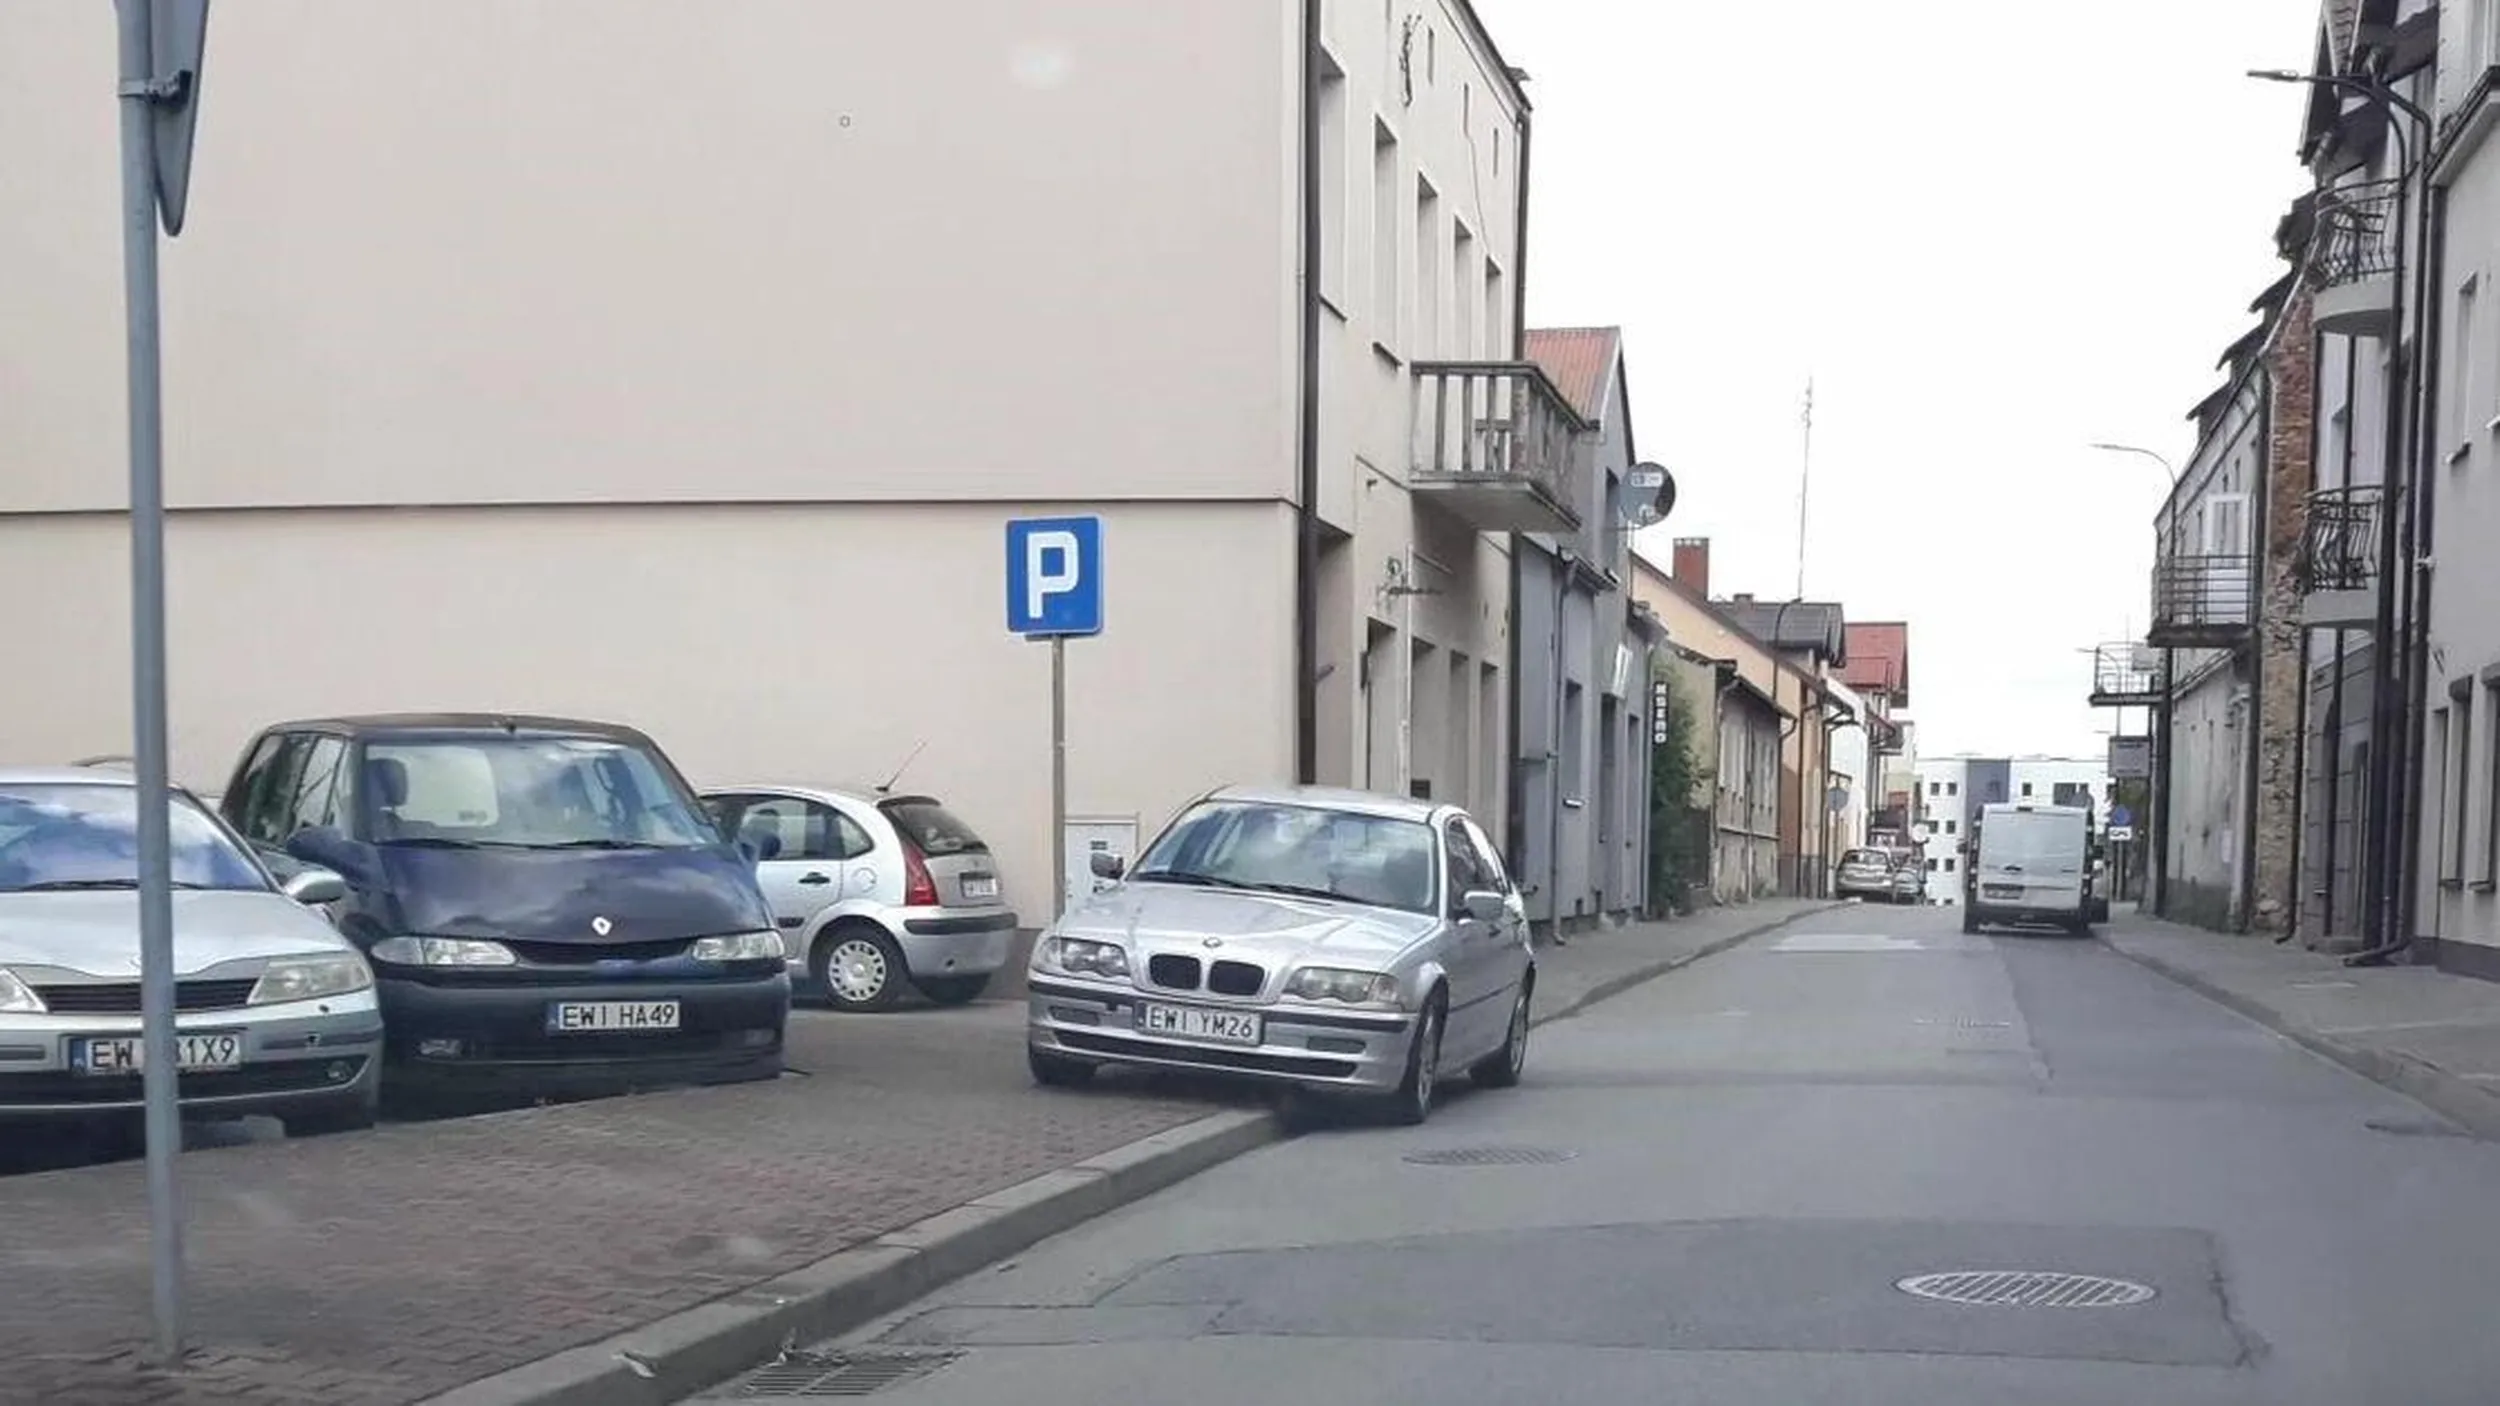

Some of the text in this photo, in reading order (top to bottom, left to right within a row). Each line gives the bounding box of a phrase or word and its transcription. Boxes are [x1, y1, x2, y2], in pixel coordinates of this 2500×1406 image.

[1027, 530, 1079, 619] P
[563, 1004, 676, 1027] EWI HA49
[1150, 1006, 1253, 1038] EWI YM26
[91, 1036, 235, 1068] EW 1X9
